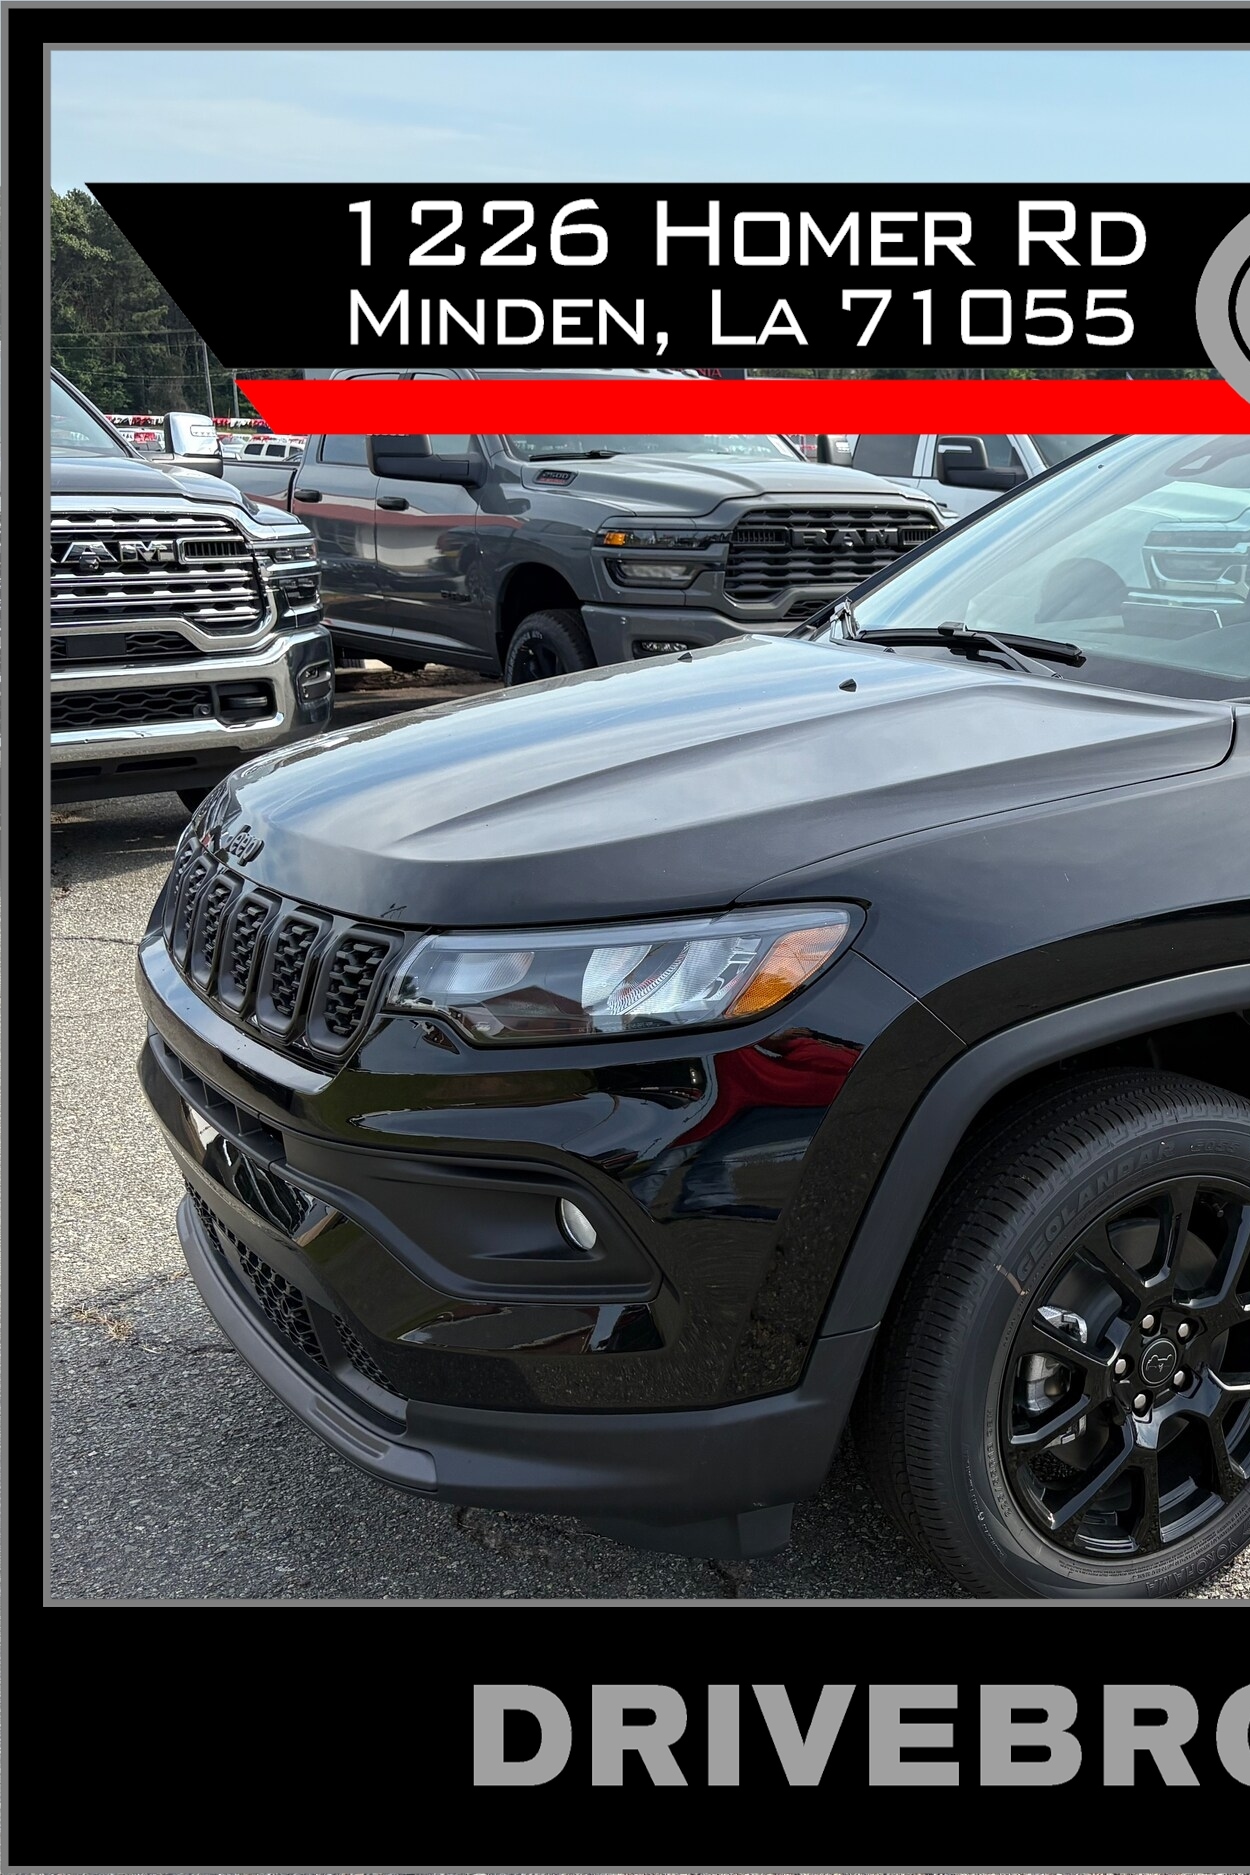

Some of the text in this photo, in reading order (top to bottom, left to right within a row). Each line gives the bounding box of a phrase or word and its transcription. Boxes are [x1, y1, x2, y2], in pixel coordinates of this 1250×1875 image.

[51, 540, 175, 563] AM
[791, 527, 898, 547] RAM
[1014, 1140, 1177, 1282] GEOLANDAR
[1145, 1537, 1239, 1597] YOKOHAMA
